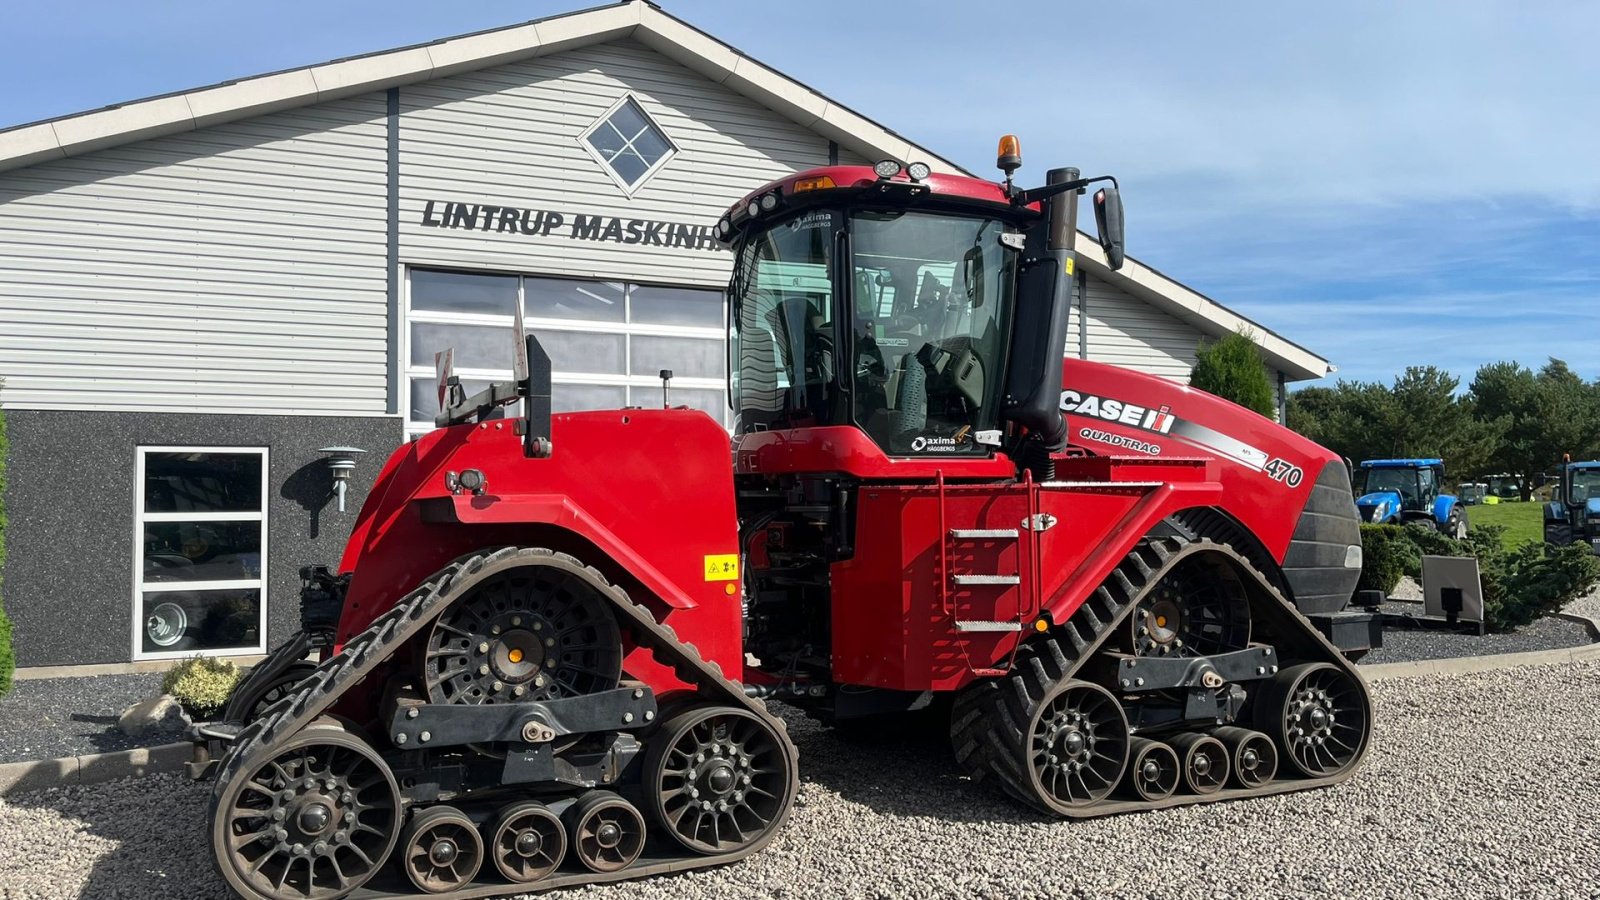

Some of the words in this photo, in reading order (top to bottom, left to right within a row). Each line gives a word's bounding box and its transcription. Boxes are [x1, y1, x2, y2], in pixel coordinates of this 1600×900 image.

[420, 200, 564, 237] LINTRUP
[569, 213, 720, 252] MASKINH
[1059, 390, 1146, 426] CASE
[927, 437, 956, 445] axima
[1079, 427, 1160, 456] QUADTRAC
[1264, 458, 1303, 488] 470
